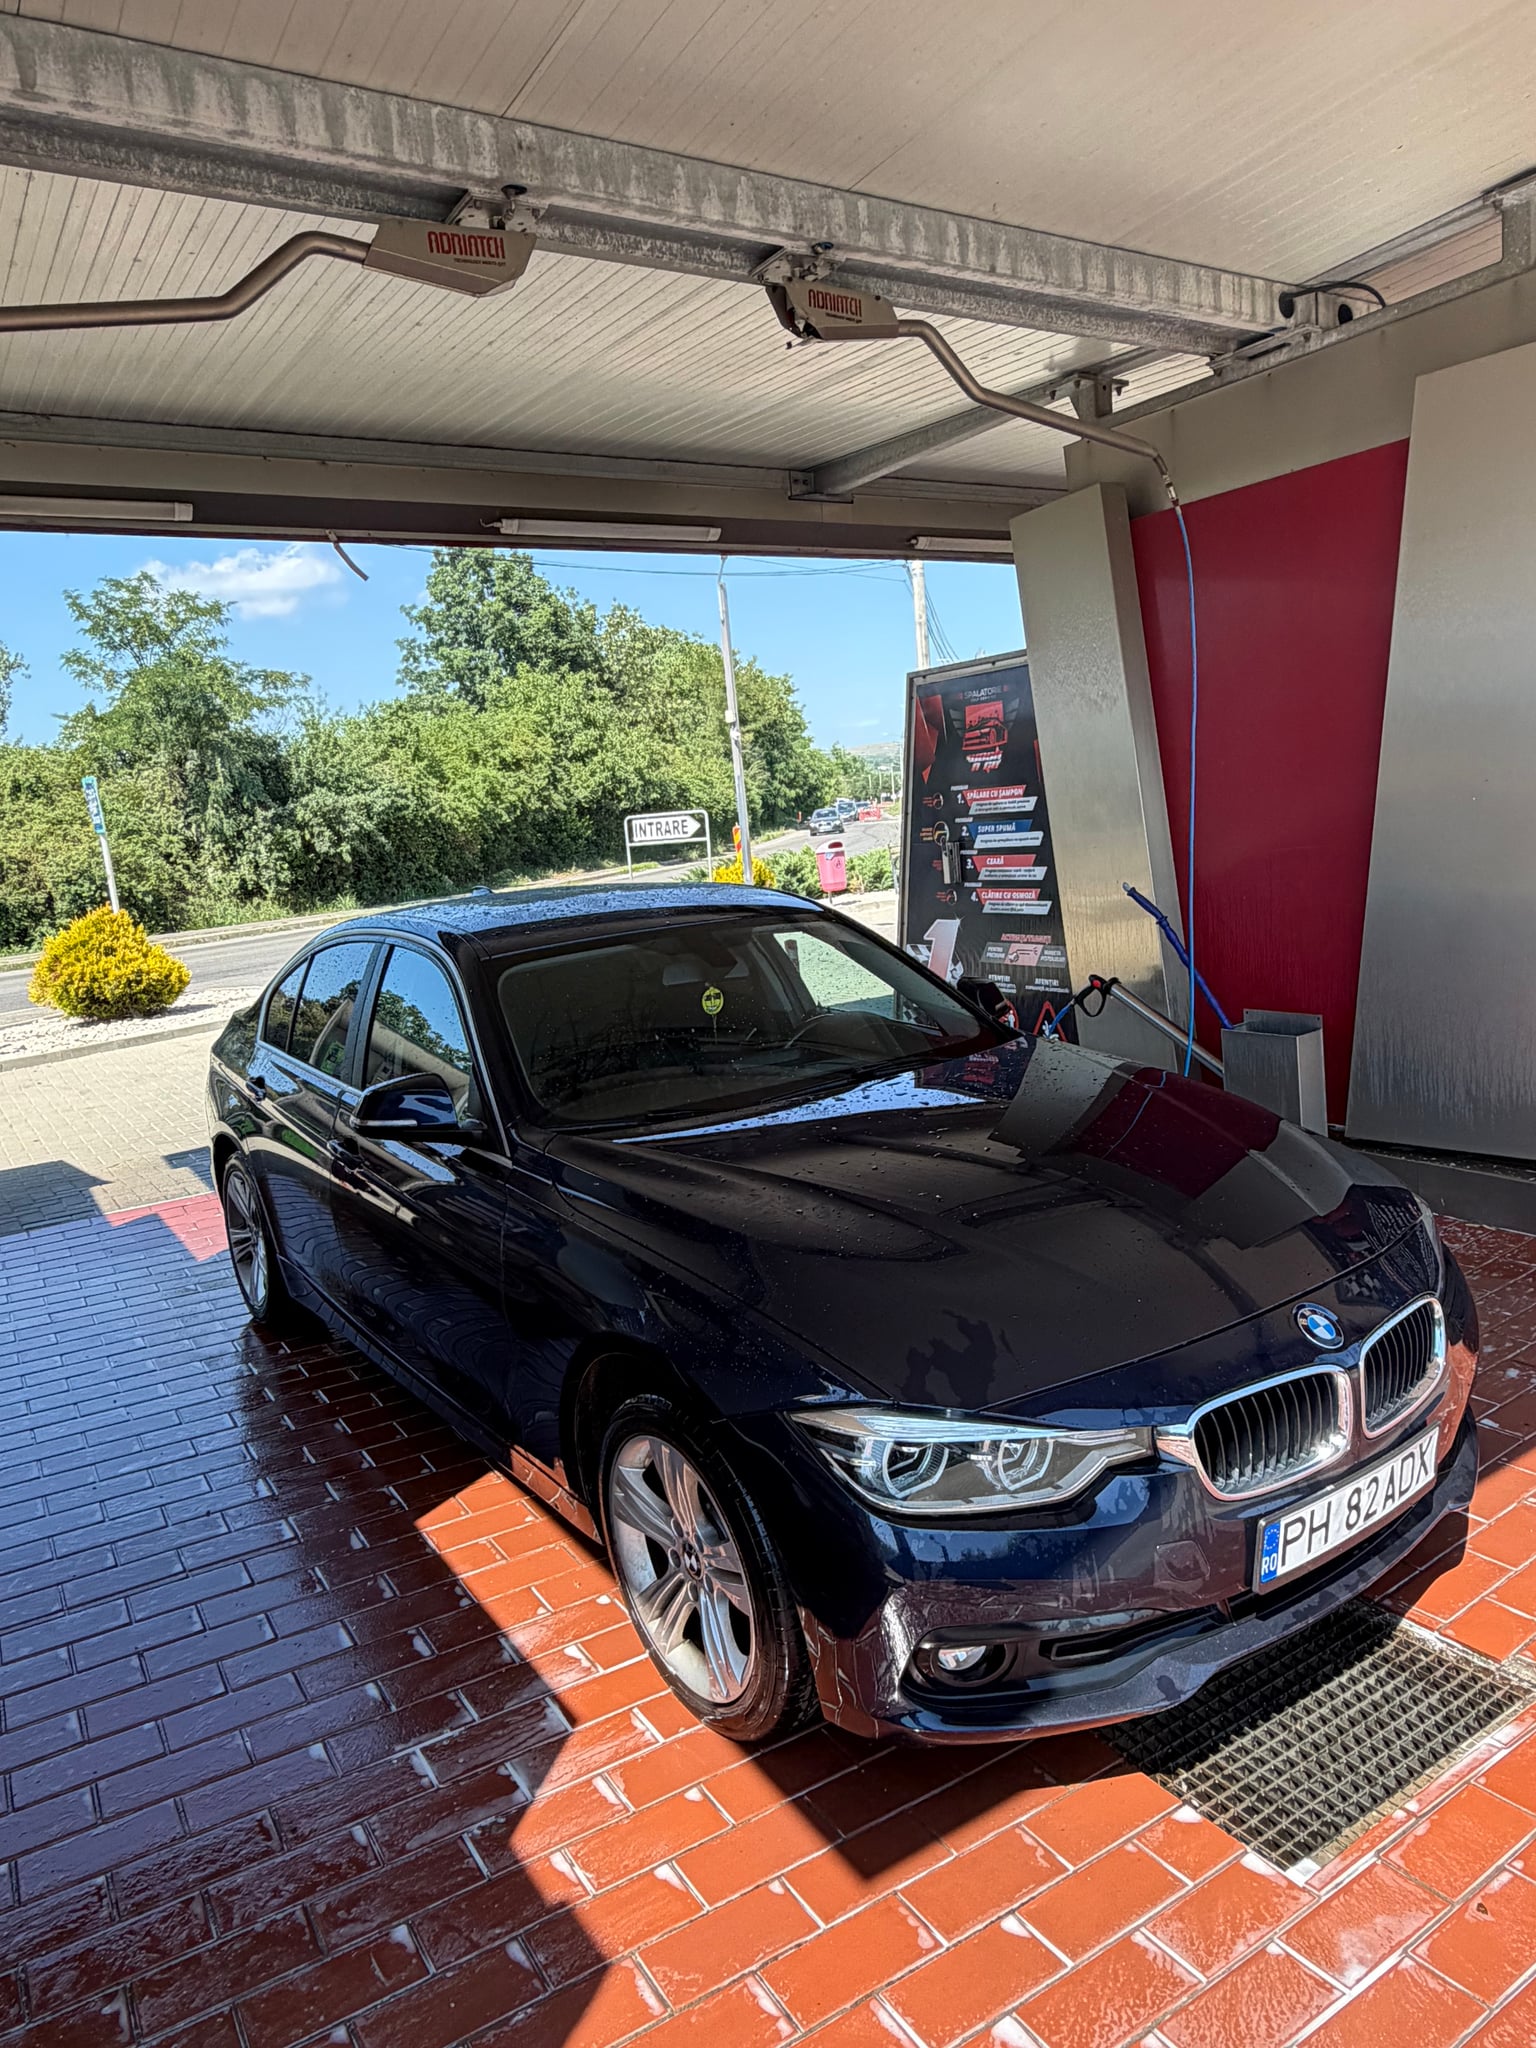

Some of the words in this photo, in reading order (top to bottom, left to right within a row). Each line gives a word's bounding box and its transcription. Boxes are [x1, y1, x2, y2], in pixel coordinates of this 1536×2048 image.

[634, 819, 689, 838] INTRARE
[977, 824, 995, 833] SUPER
[1280, 1500, 1332, 1567] PH
[1261, 1552, 1278, 1575] RO
